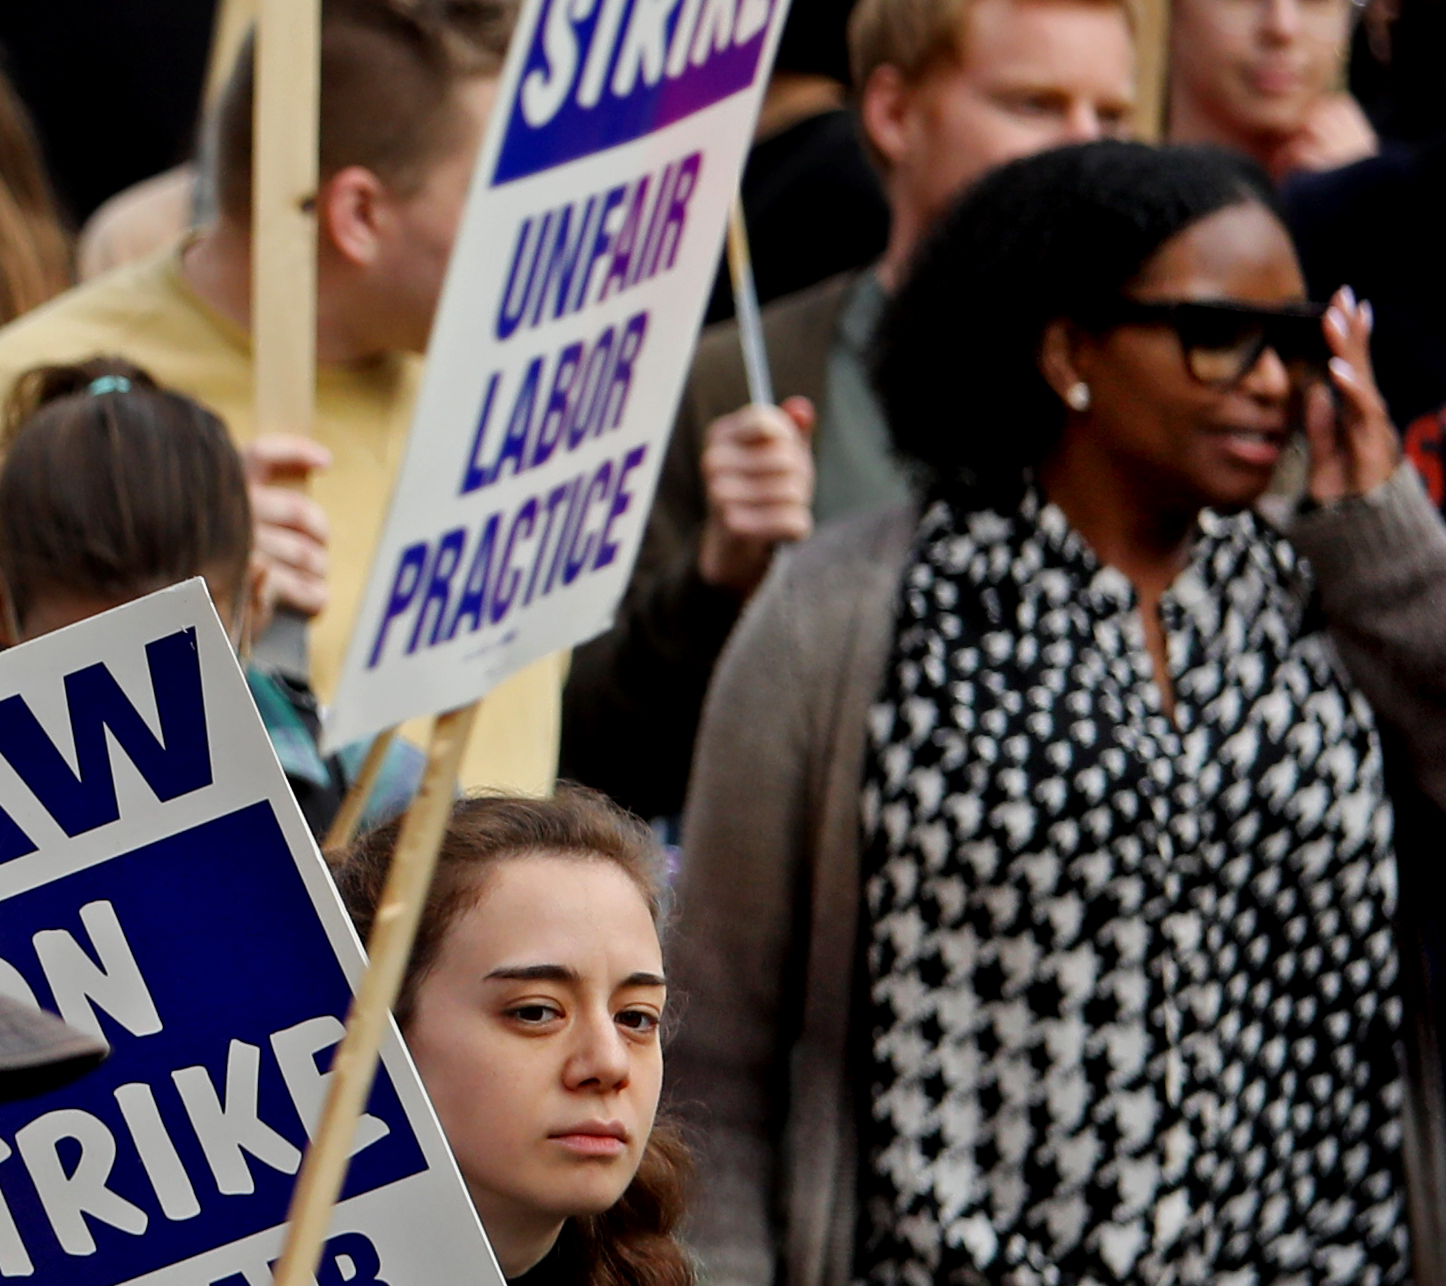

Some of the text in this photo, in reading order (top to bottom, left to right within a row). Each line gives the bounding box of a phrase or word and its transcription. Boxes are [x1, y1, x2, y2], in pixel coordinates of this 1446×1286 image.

[491, 149, 705, 345] UNFAIR
[456, 309, 653, 503] LABOR
[363, 443, 651, 673] PRACTICE
